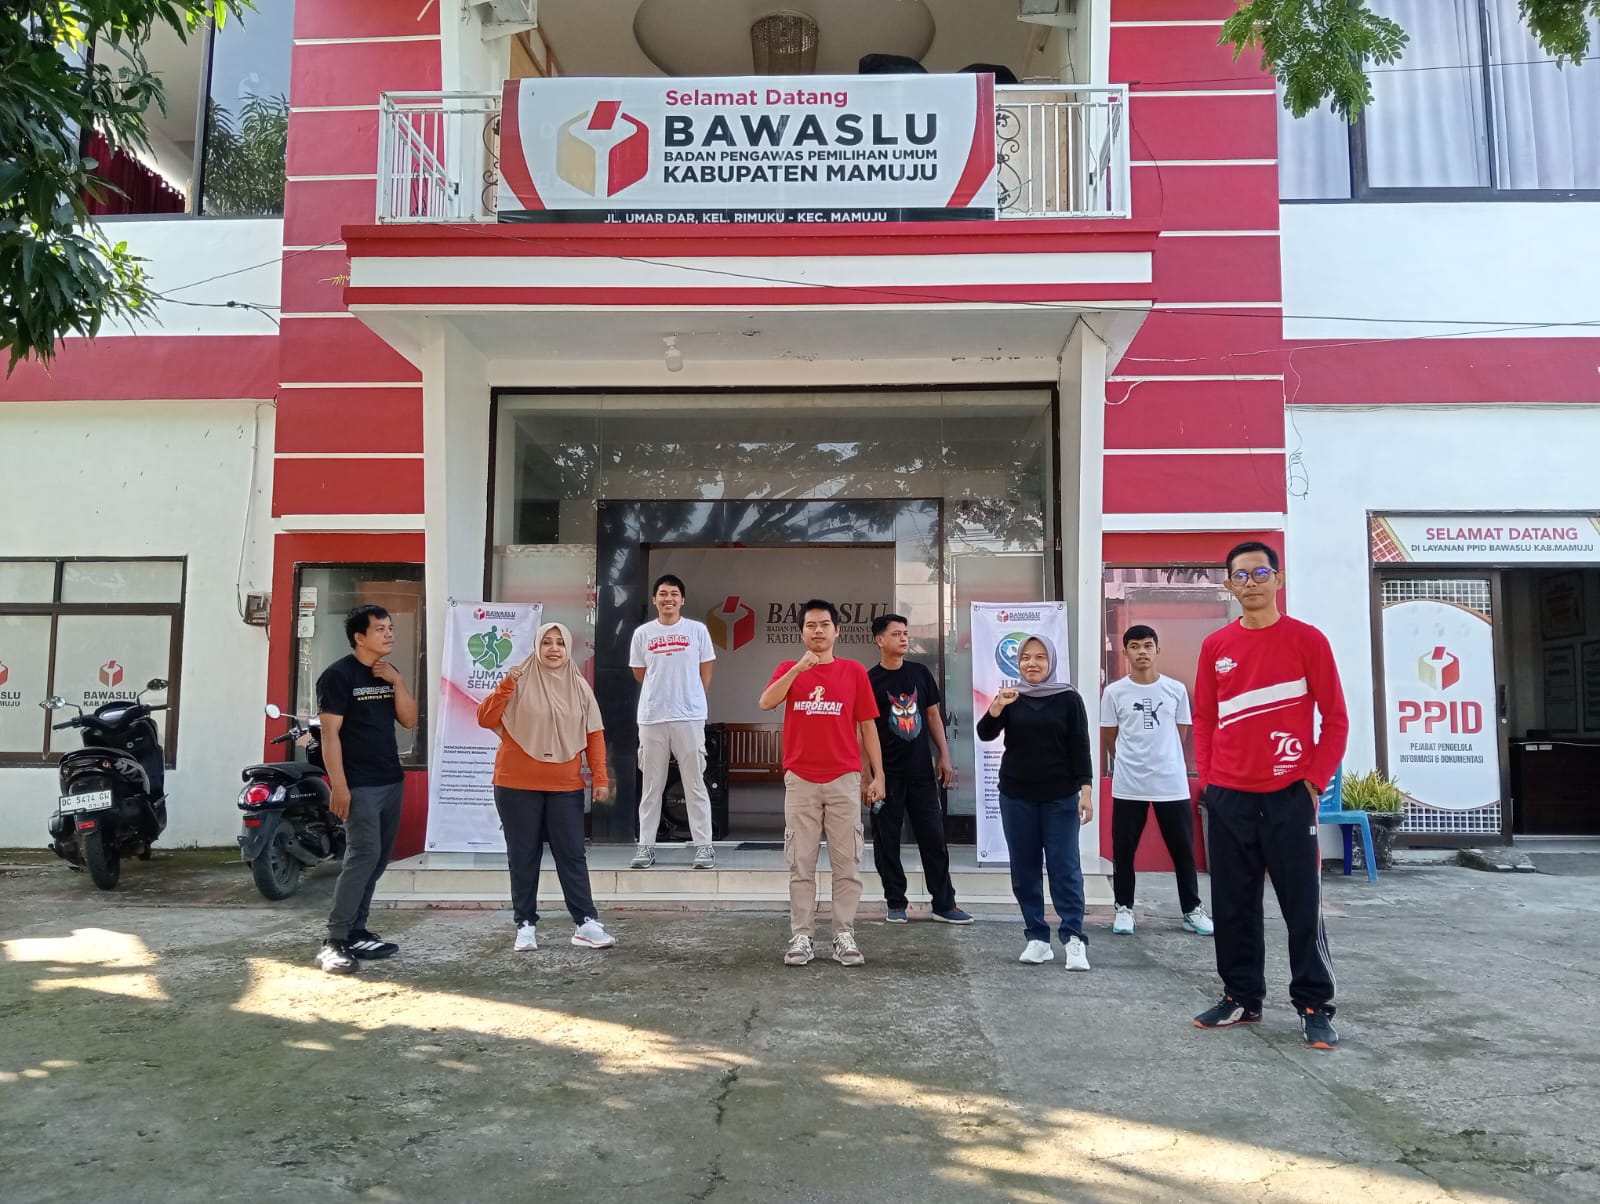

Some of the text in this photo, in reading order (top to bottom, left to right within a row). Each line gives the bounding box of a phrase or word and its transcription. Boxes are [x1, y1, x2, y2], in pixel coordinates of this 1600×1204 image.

[665, 89, 848, 108] Selamat Datang
[664, 113, 937, 147] BAWASLU
[664, 149, 937, 162] BADAN PENGAWAS PEMILIHAN UMUM
[663, 164, 937, 183] KABUPATEN MAMUJU
[603, 213, 622, 224] JL.
[625, 213, 664, 224] UMAR
[667, 213, 699, 225] DAR,
[702, 212, 730, 224] KEL.
[734, 212, 785, 223] RIMUKU
[797, 212, 827, 223] KEC.
[830, 212, 887, 222] MAMUJU
[1426, 527, 1578, 541] SELAMAT DATANG
[1411, 544, 1421, 552] DI
[1422, 544, 1464, 552] LAYANAN
[1466, 544, 1487, 552] PPID
[1489, 544, 1532, 552] BAWASLU
[83, 691, 137, 700] BAWASLU
[1398, 700, 1483, 734] PPID
[1410, 742, 1472, 752] PEJABAT PENGELOLA
[1400, 754, 1433, 763] INFORMASI
[1441, 755, 1484, 764] DOKUMENTASI
